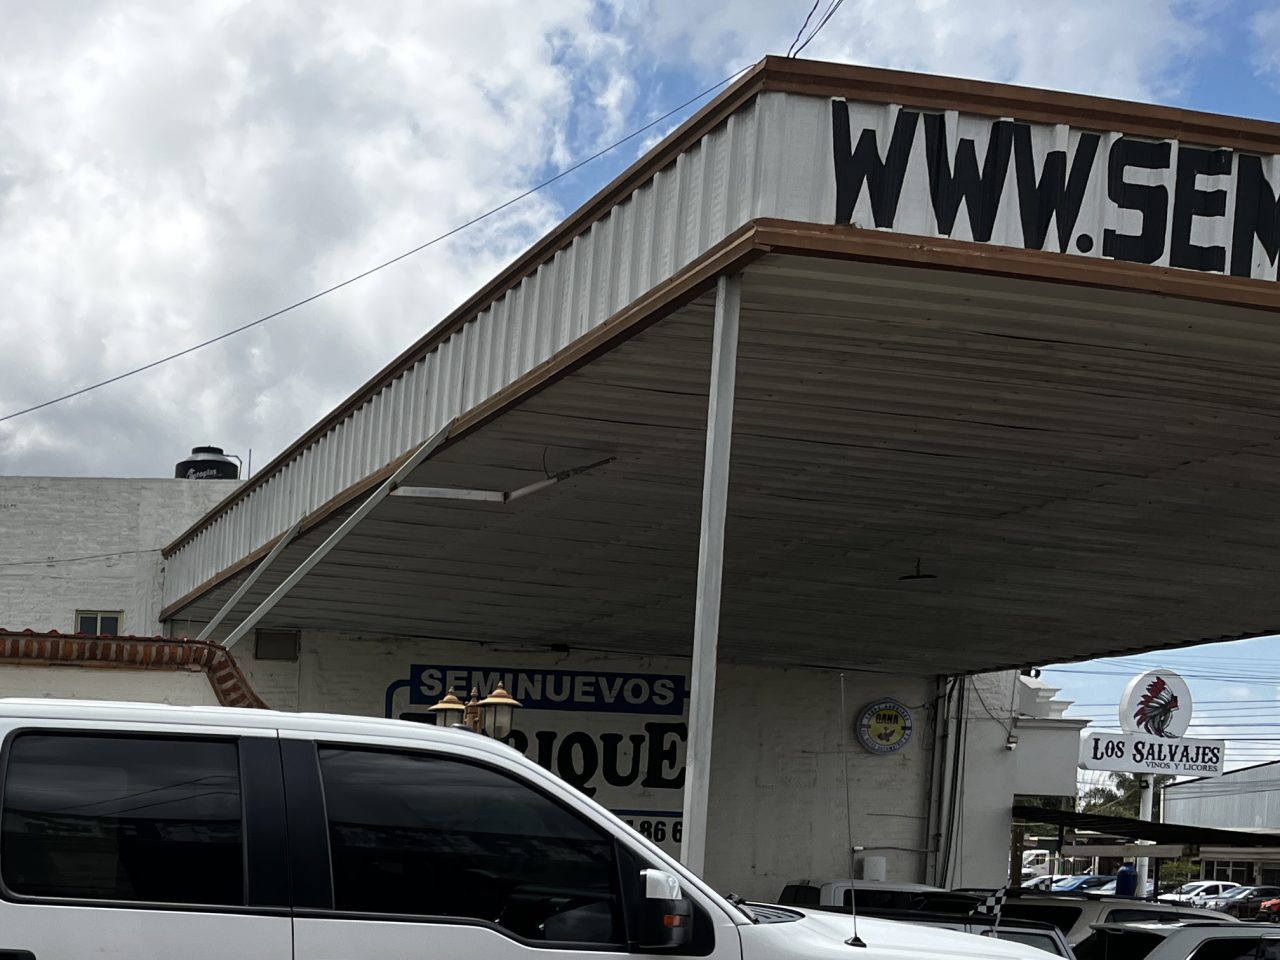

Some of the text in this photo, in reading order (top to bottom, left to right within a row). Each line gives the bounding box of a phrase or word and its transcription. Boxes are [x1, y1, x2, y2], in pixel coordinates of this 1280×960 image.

[420, 669, 675, 706] SEMINUEVOS
[1092, 738, 1220, 764] LOS SALVAJES
[1145, 761, 1171, 769] VINOS
[1183, 764, 1218, 772] LICORES
